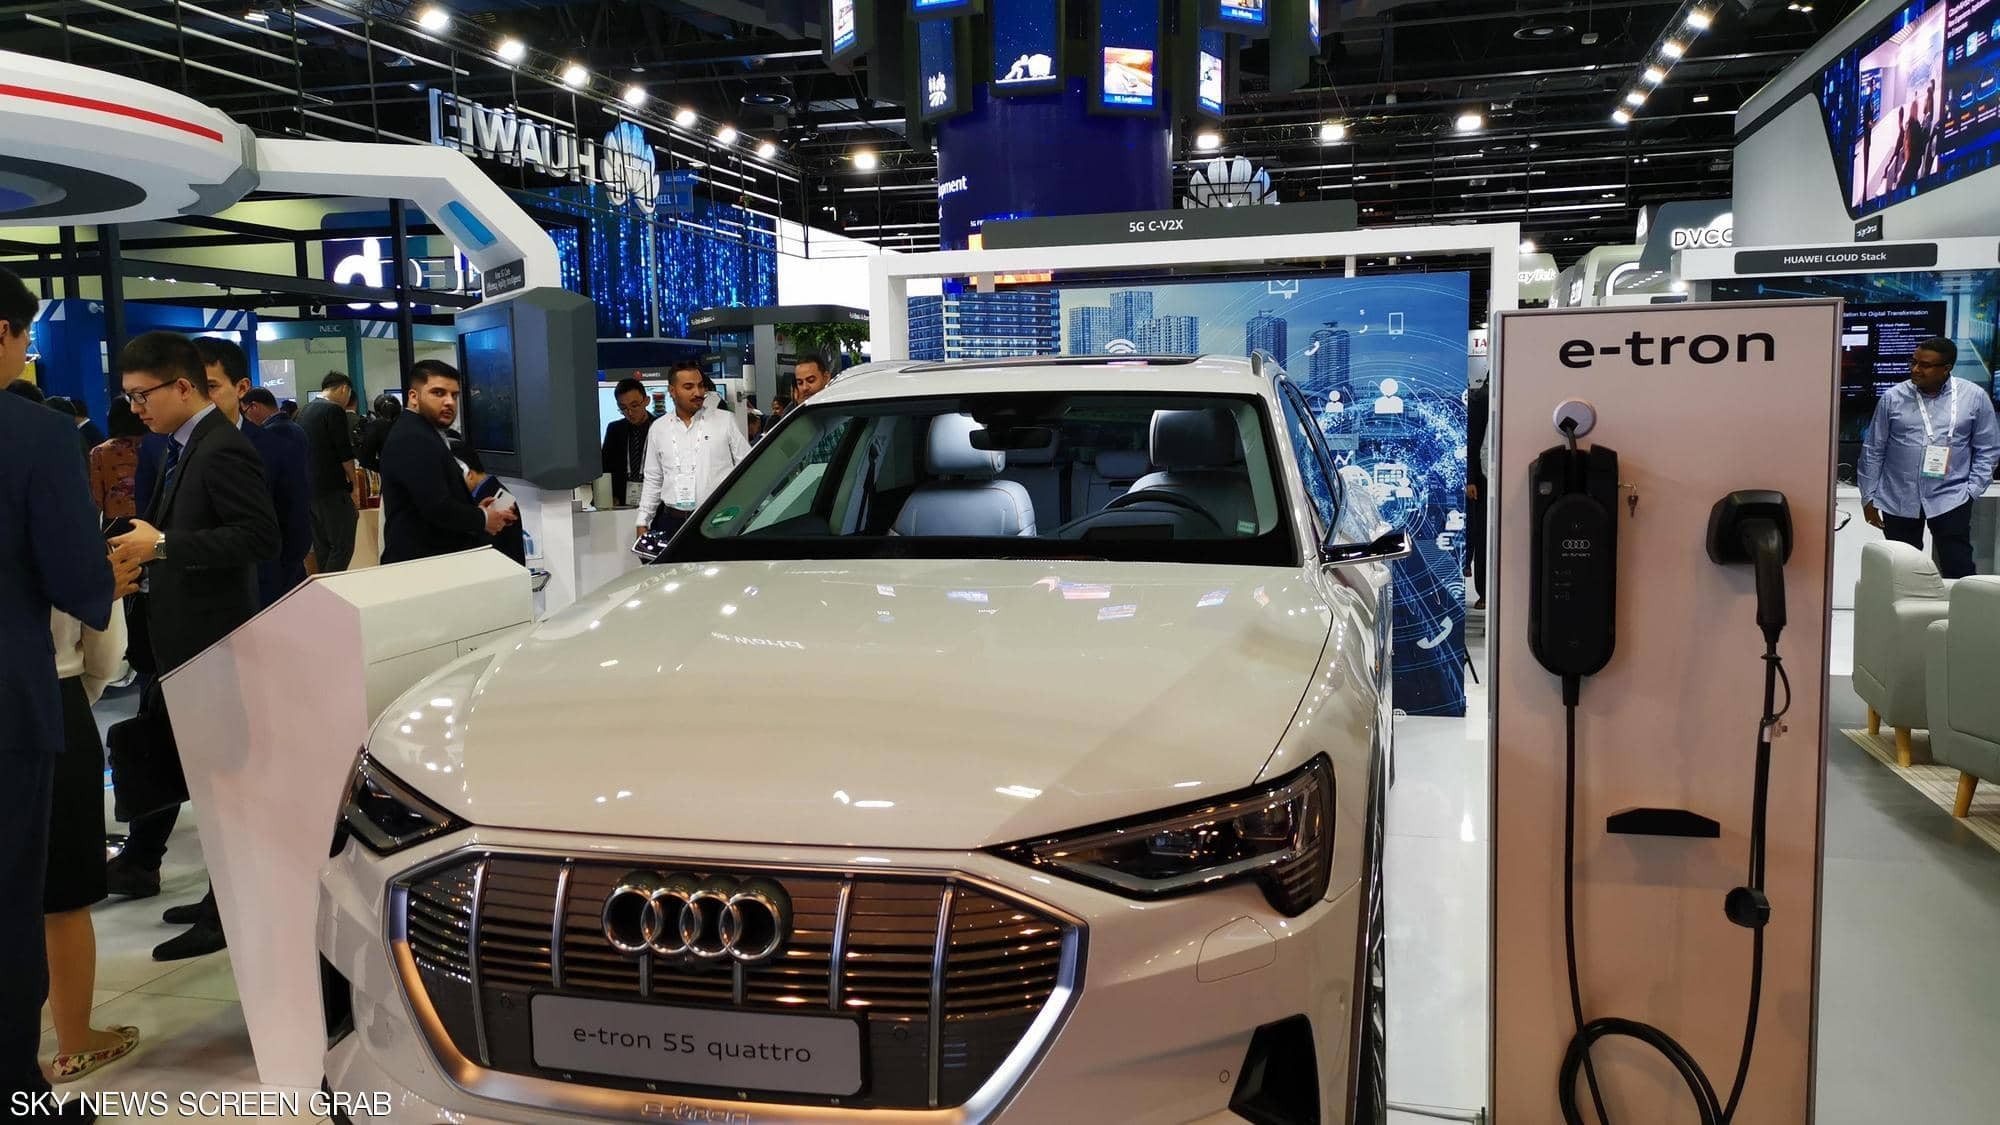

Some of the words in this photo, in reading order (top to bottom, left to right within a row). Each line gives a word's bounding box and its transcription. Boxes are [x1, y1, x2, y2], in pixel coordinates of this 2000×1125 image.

[938, 175, 968, 200] pment
[1129, 221, 1145, 233] 5G
[1148, 219, 1184, 231] C-V2X
[1783, 255, 1823, 264] HUAWEI
[1825, 254, 1858, 263] CLOUD
[1861, 252, 1887, 261] Stack
[320, 325, 341, 333] NEC
[1559, 331, 1775, 369] e-tron
[263, 378, 285, 387] NEC
[573, 1026, 651, 1049] e-tron
[663, 1033, 695, 1053] 55
[707, 1039, 811, 1063] quattro
